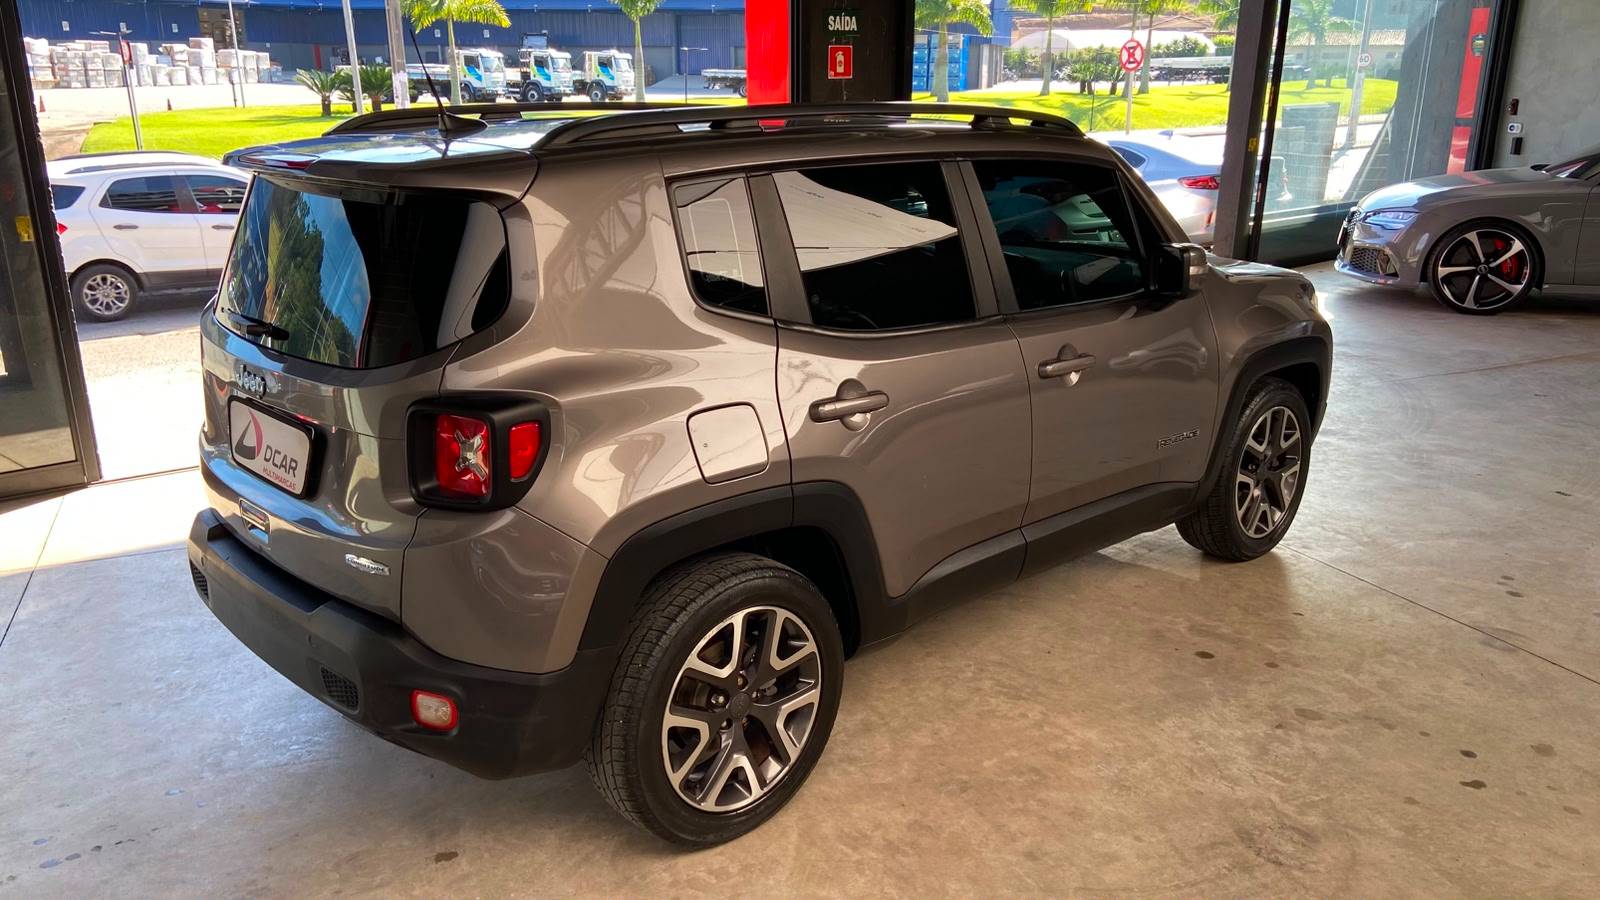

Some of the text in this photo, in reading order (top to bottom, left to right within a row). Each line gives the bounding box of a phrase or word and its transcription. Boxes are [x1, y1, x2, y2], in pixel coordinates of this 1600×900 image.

[828, 12, 857, 31] SAÍDA
[236, 364, 266, 399] Jeep
[263, 444, 298, 478] DCAR
[262, 466, 297, 490] MULTIMARCAS
